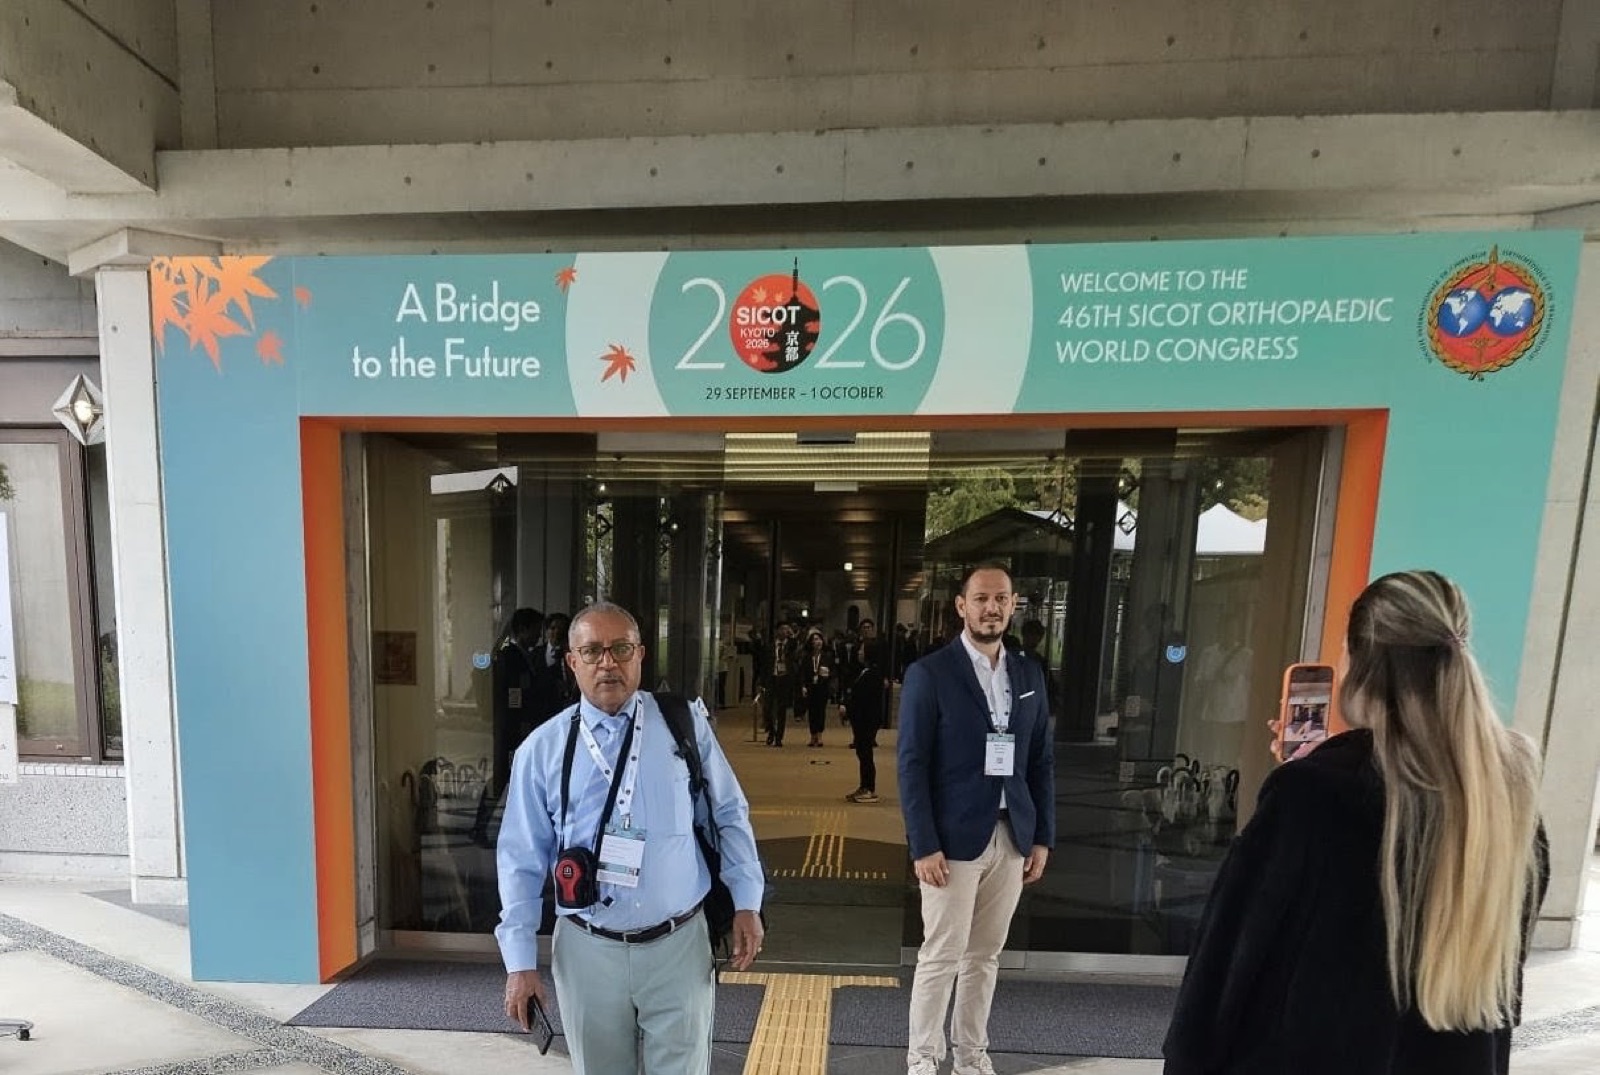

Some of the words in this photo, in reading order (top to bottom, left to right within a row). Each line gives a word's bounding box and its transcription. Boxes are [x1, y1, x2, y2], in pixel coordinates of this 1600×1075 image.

[1060, 272, 1170, 293] WELCOME
[1177, 270, 1205, 290] TO
[1211, 268, 1248, 290] THE
[396, 283, 427, 323] A
[435, 280, 540, 331] Bridge
[736, 305, 801, 325] SICOT
[1058, 304, 1121, 328] 46TH
[1126, 301, 1202, 327] SICOT
[1207, 297, 1394, 326] ORTHOPAEDIC
[740, 327, 775, 338] KYOTO
[745, 338, 770, 349] 2026
[352, 346, 381, 378] to
[390, 337, 436, 378] the
[444, 338, 540, 378] Future
[785, 330, 799, 362] 京都
[1056, 339, 1149, 363] WORLD
[1156, 336, 1299, 361] CONGRESS
[706, 387, 722, 400] 29
[725, 387, 796, 400] SEPTEMBER
[811, 387, 816, 399] 1
[820, 386, 884, 399] OCTOBER
